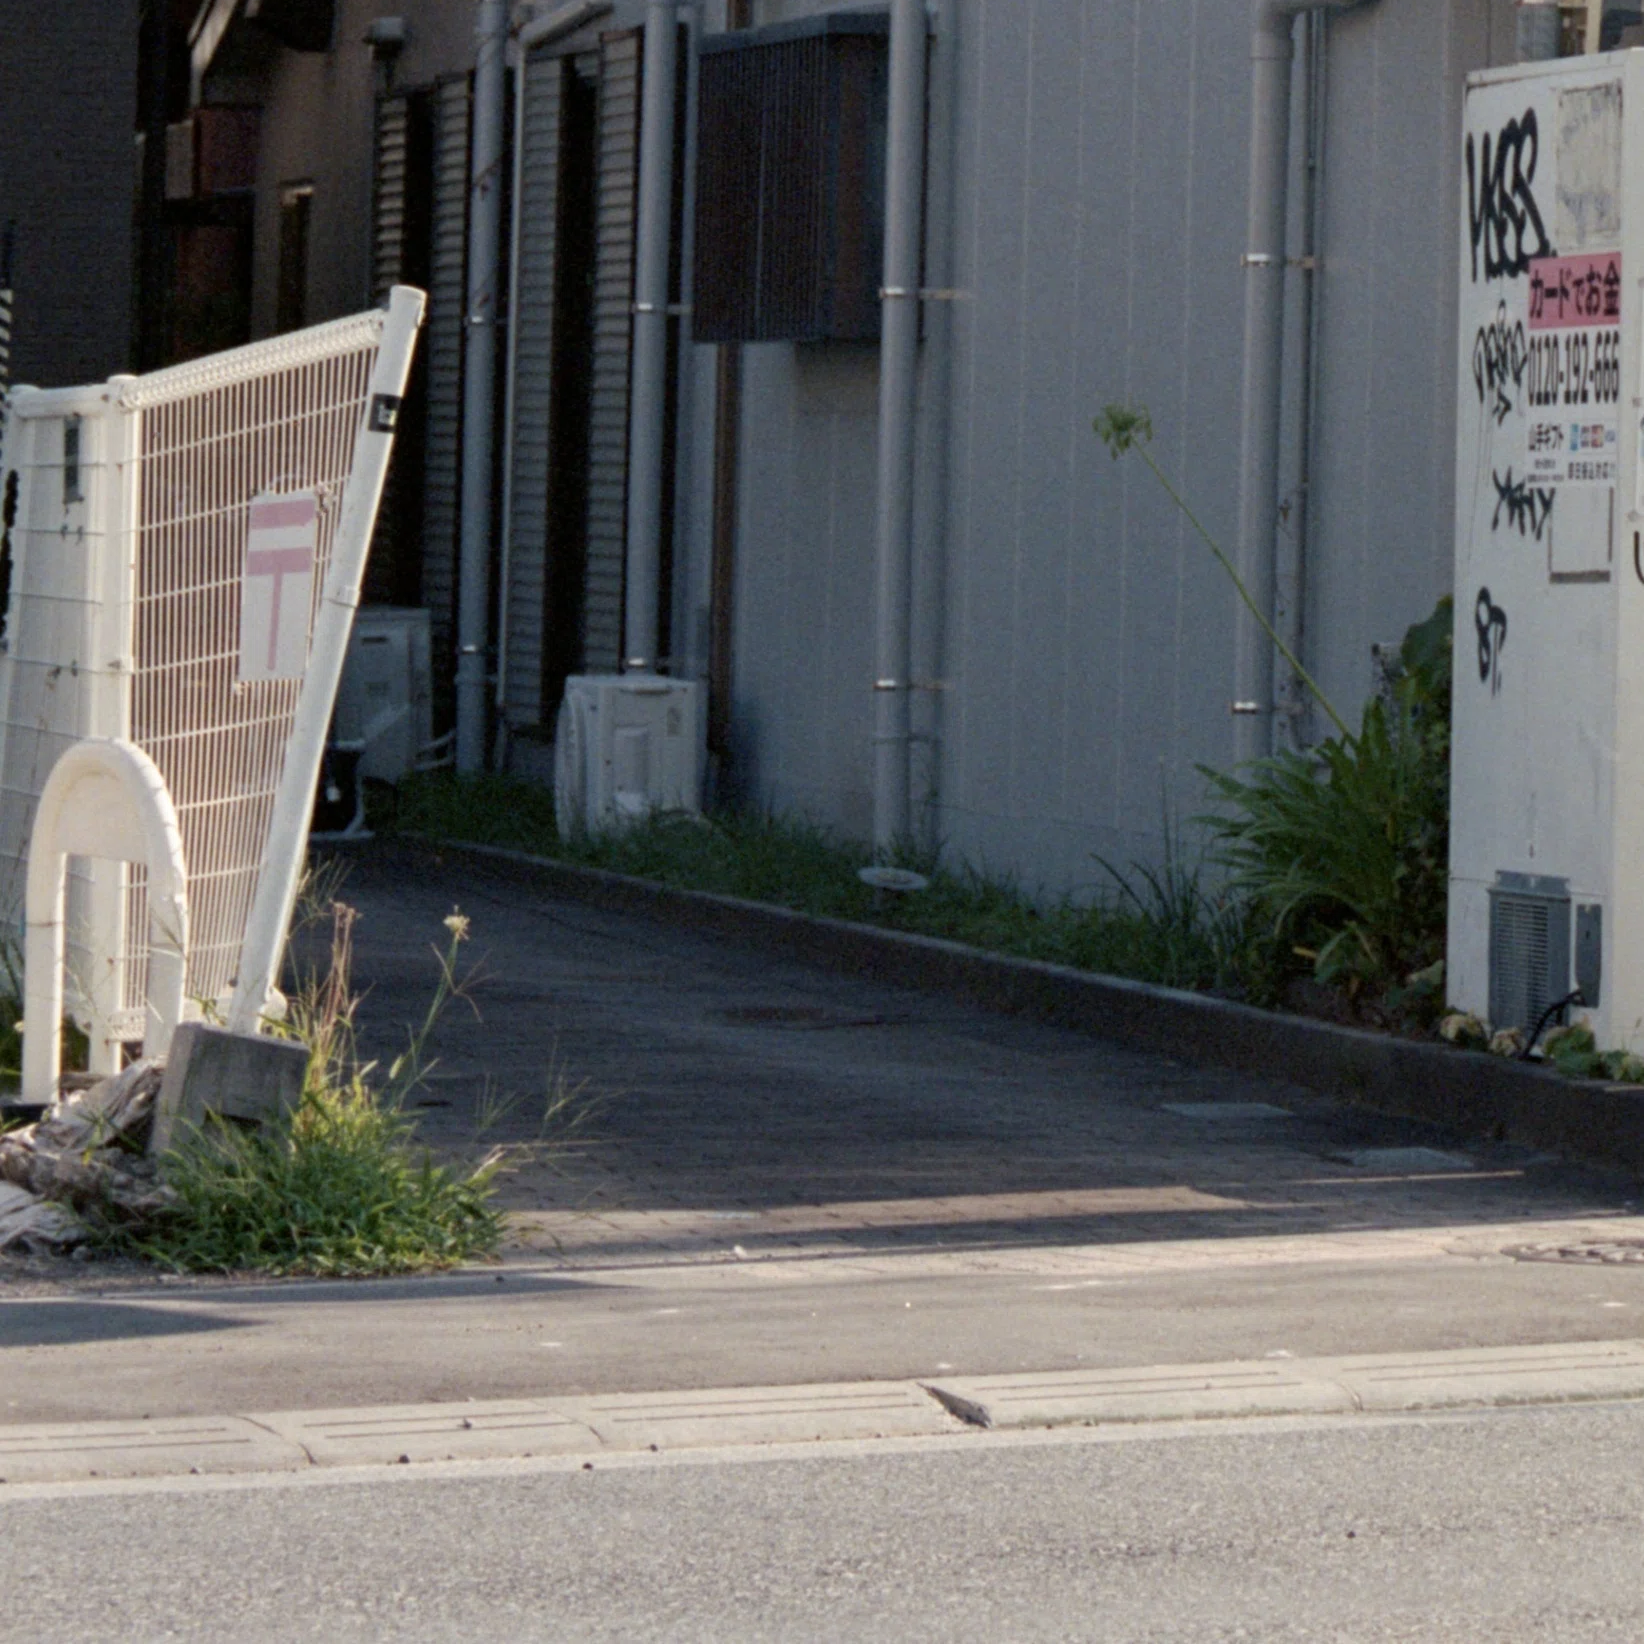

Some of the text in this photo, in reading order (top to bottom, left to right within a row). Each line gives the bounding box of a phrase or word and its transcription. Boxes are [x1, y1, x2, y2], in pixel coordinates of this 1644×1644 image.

[1529, 259, 1620, 319] カードでお金
[1528, 330, 1619, 406] 0120-192-666
